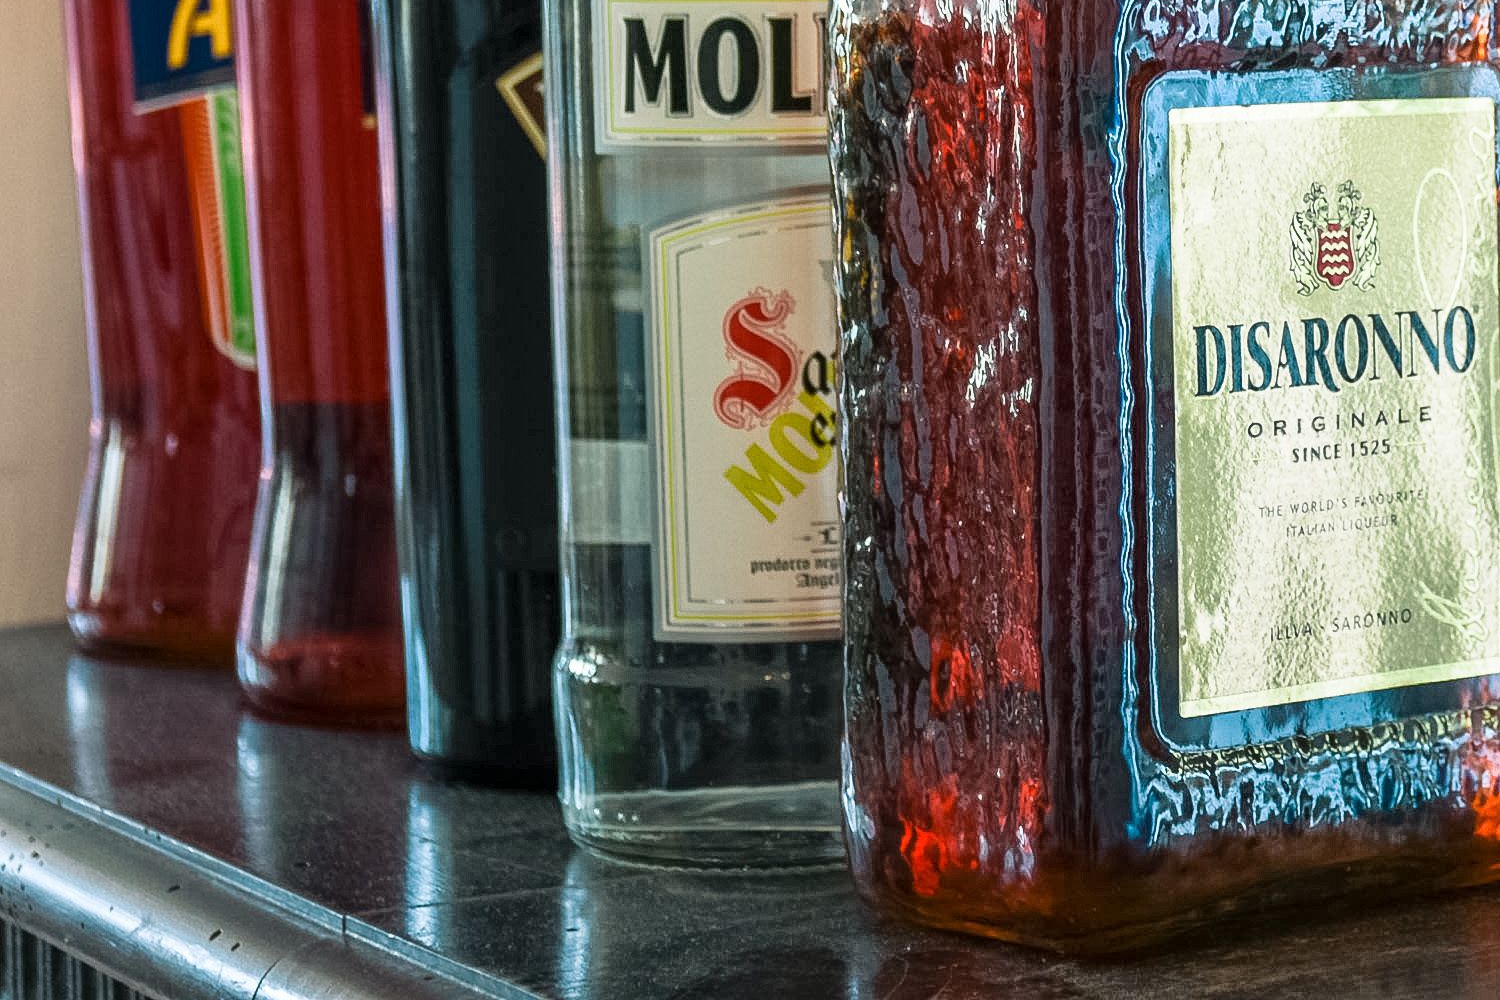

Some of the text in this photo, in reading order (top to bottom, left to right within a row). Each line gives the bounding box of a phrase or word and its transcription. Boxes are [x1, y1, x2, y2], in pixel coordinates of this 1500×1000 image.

[1193, 305, 1476, 397] DISARONNO
[1248, 406, 1432, 438] ORIGINALE
[1292, 439, 1391, 463] SINCE 1525
[1258, 489, 1424, 519] THE WORLD'S FAVOURITE
[1286, 514, 1398, 538] ITALIAN LIQUEUR
[1270, 608, 1412, 642] ILLVA SARONNO
